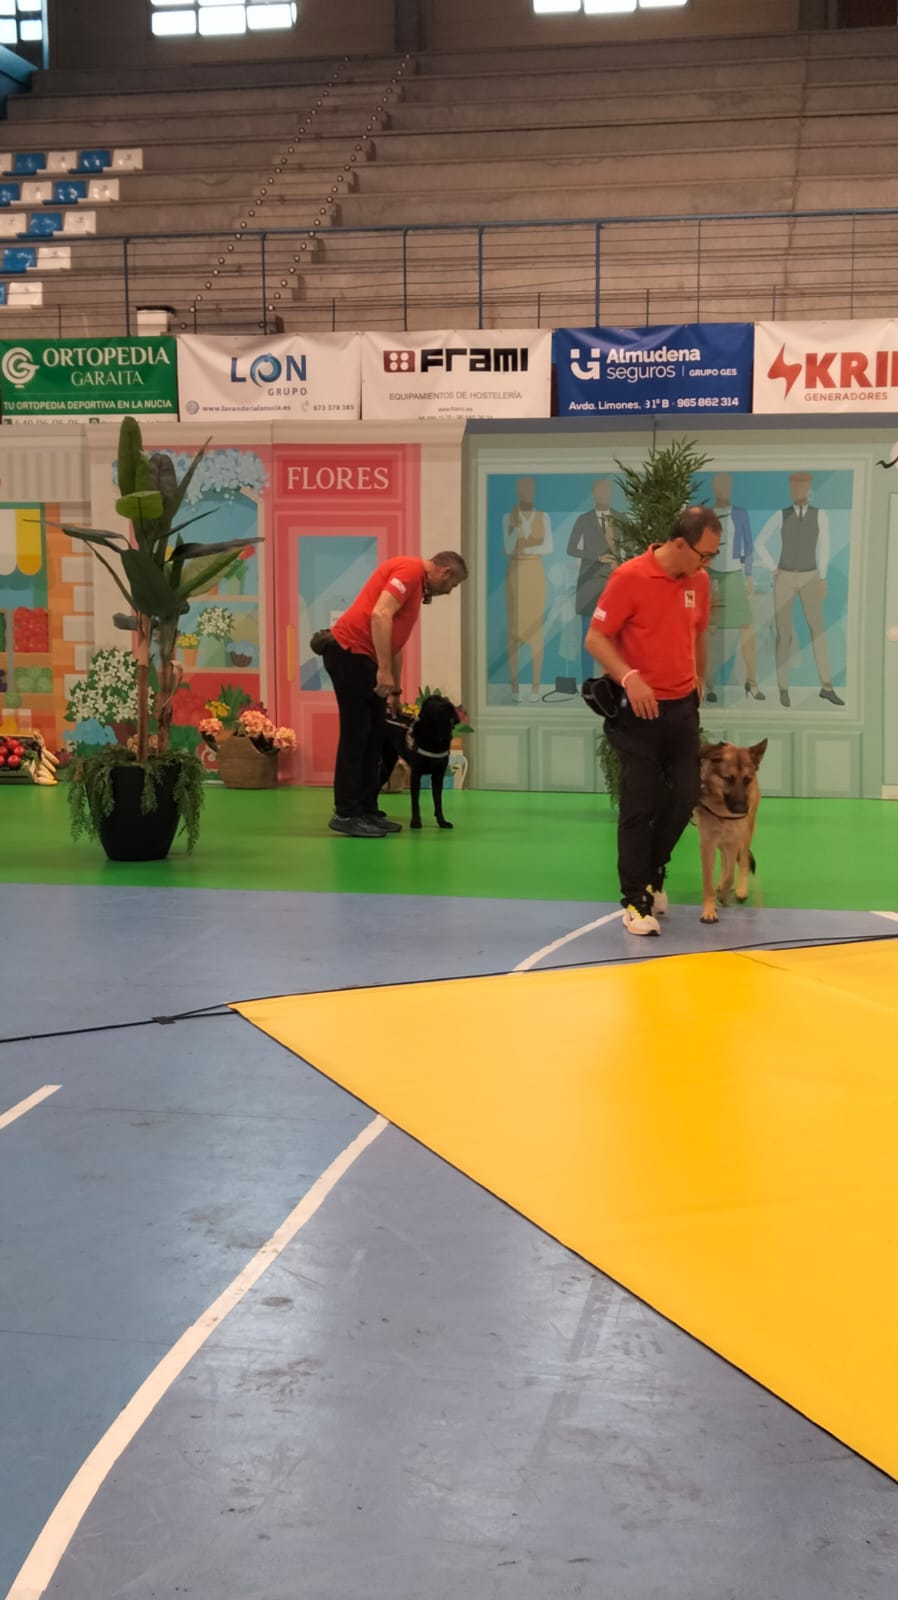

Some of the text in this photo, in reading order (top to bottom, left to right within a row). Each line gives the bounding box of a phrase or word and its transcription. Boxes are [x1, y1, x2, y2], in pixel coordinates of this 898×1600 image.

[43, 346, 170, 366] ORTOPEDIA
[606, 346, 700, 364] Almudena
[231, 353, 307, 388] LON
[607, 365, 676, 383] seguros
[689, 368, 737, 376] GRUPO GES
[71, 371, 144, 386] GARAITA
[268, 388, 307, 396] GRUPO
[389, 392, 454, 401] EQUIPAMIENTOS
[470, 391, 522, 399] HOSTELERÍA
[804, 392, 888, 401] GENERADORES
[4, 400, 172, 410] TU ORTOPEDIA DEPORTIVA EN LA NUCIA
[662, 399, 669, 408] B
[677, 398, 696, 408] 965
[698, 397, 719, 407] 862
[720, 397, 739, 406] 314
[288, 467, 389, 489] FLORES
